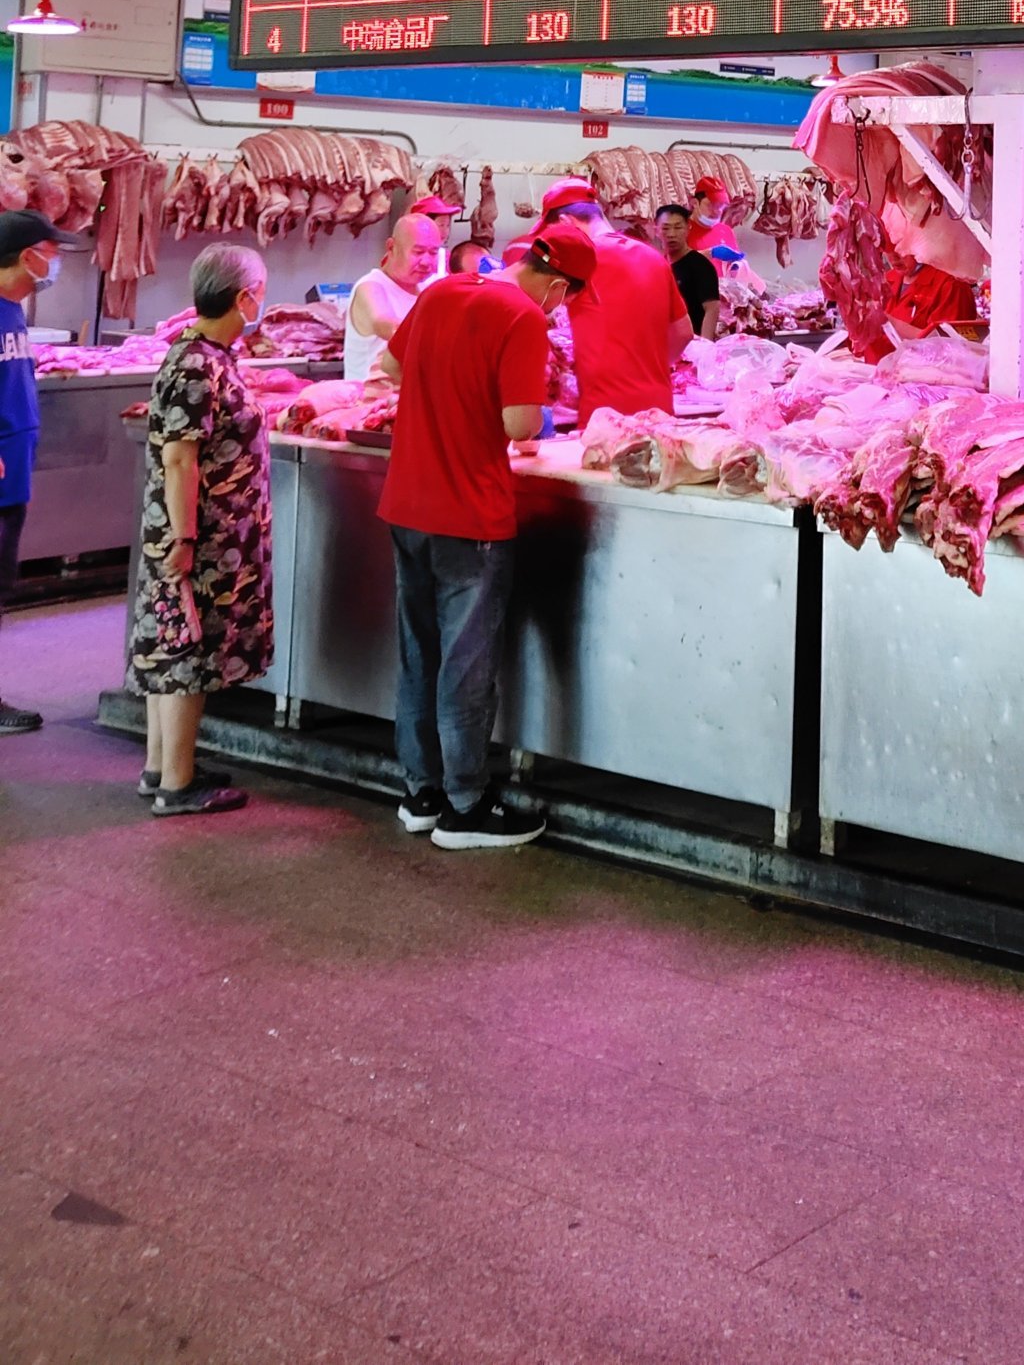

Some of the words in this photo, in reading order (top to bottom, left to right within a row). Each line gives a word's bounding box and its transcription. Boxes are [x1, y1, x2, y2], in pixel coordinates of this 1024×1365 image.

[267, 25, 281, 53] 4
[343, 13, 449, 51] 中瑞食品厂
[526, 11, 569, 42] 130
[667, 5, 714, 36] 130
[588, 125, 604, 136] 102
